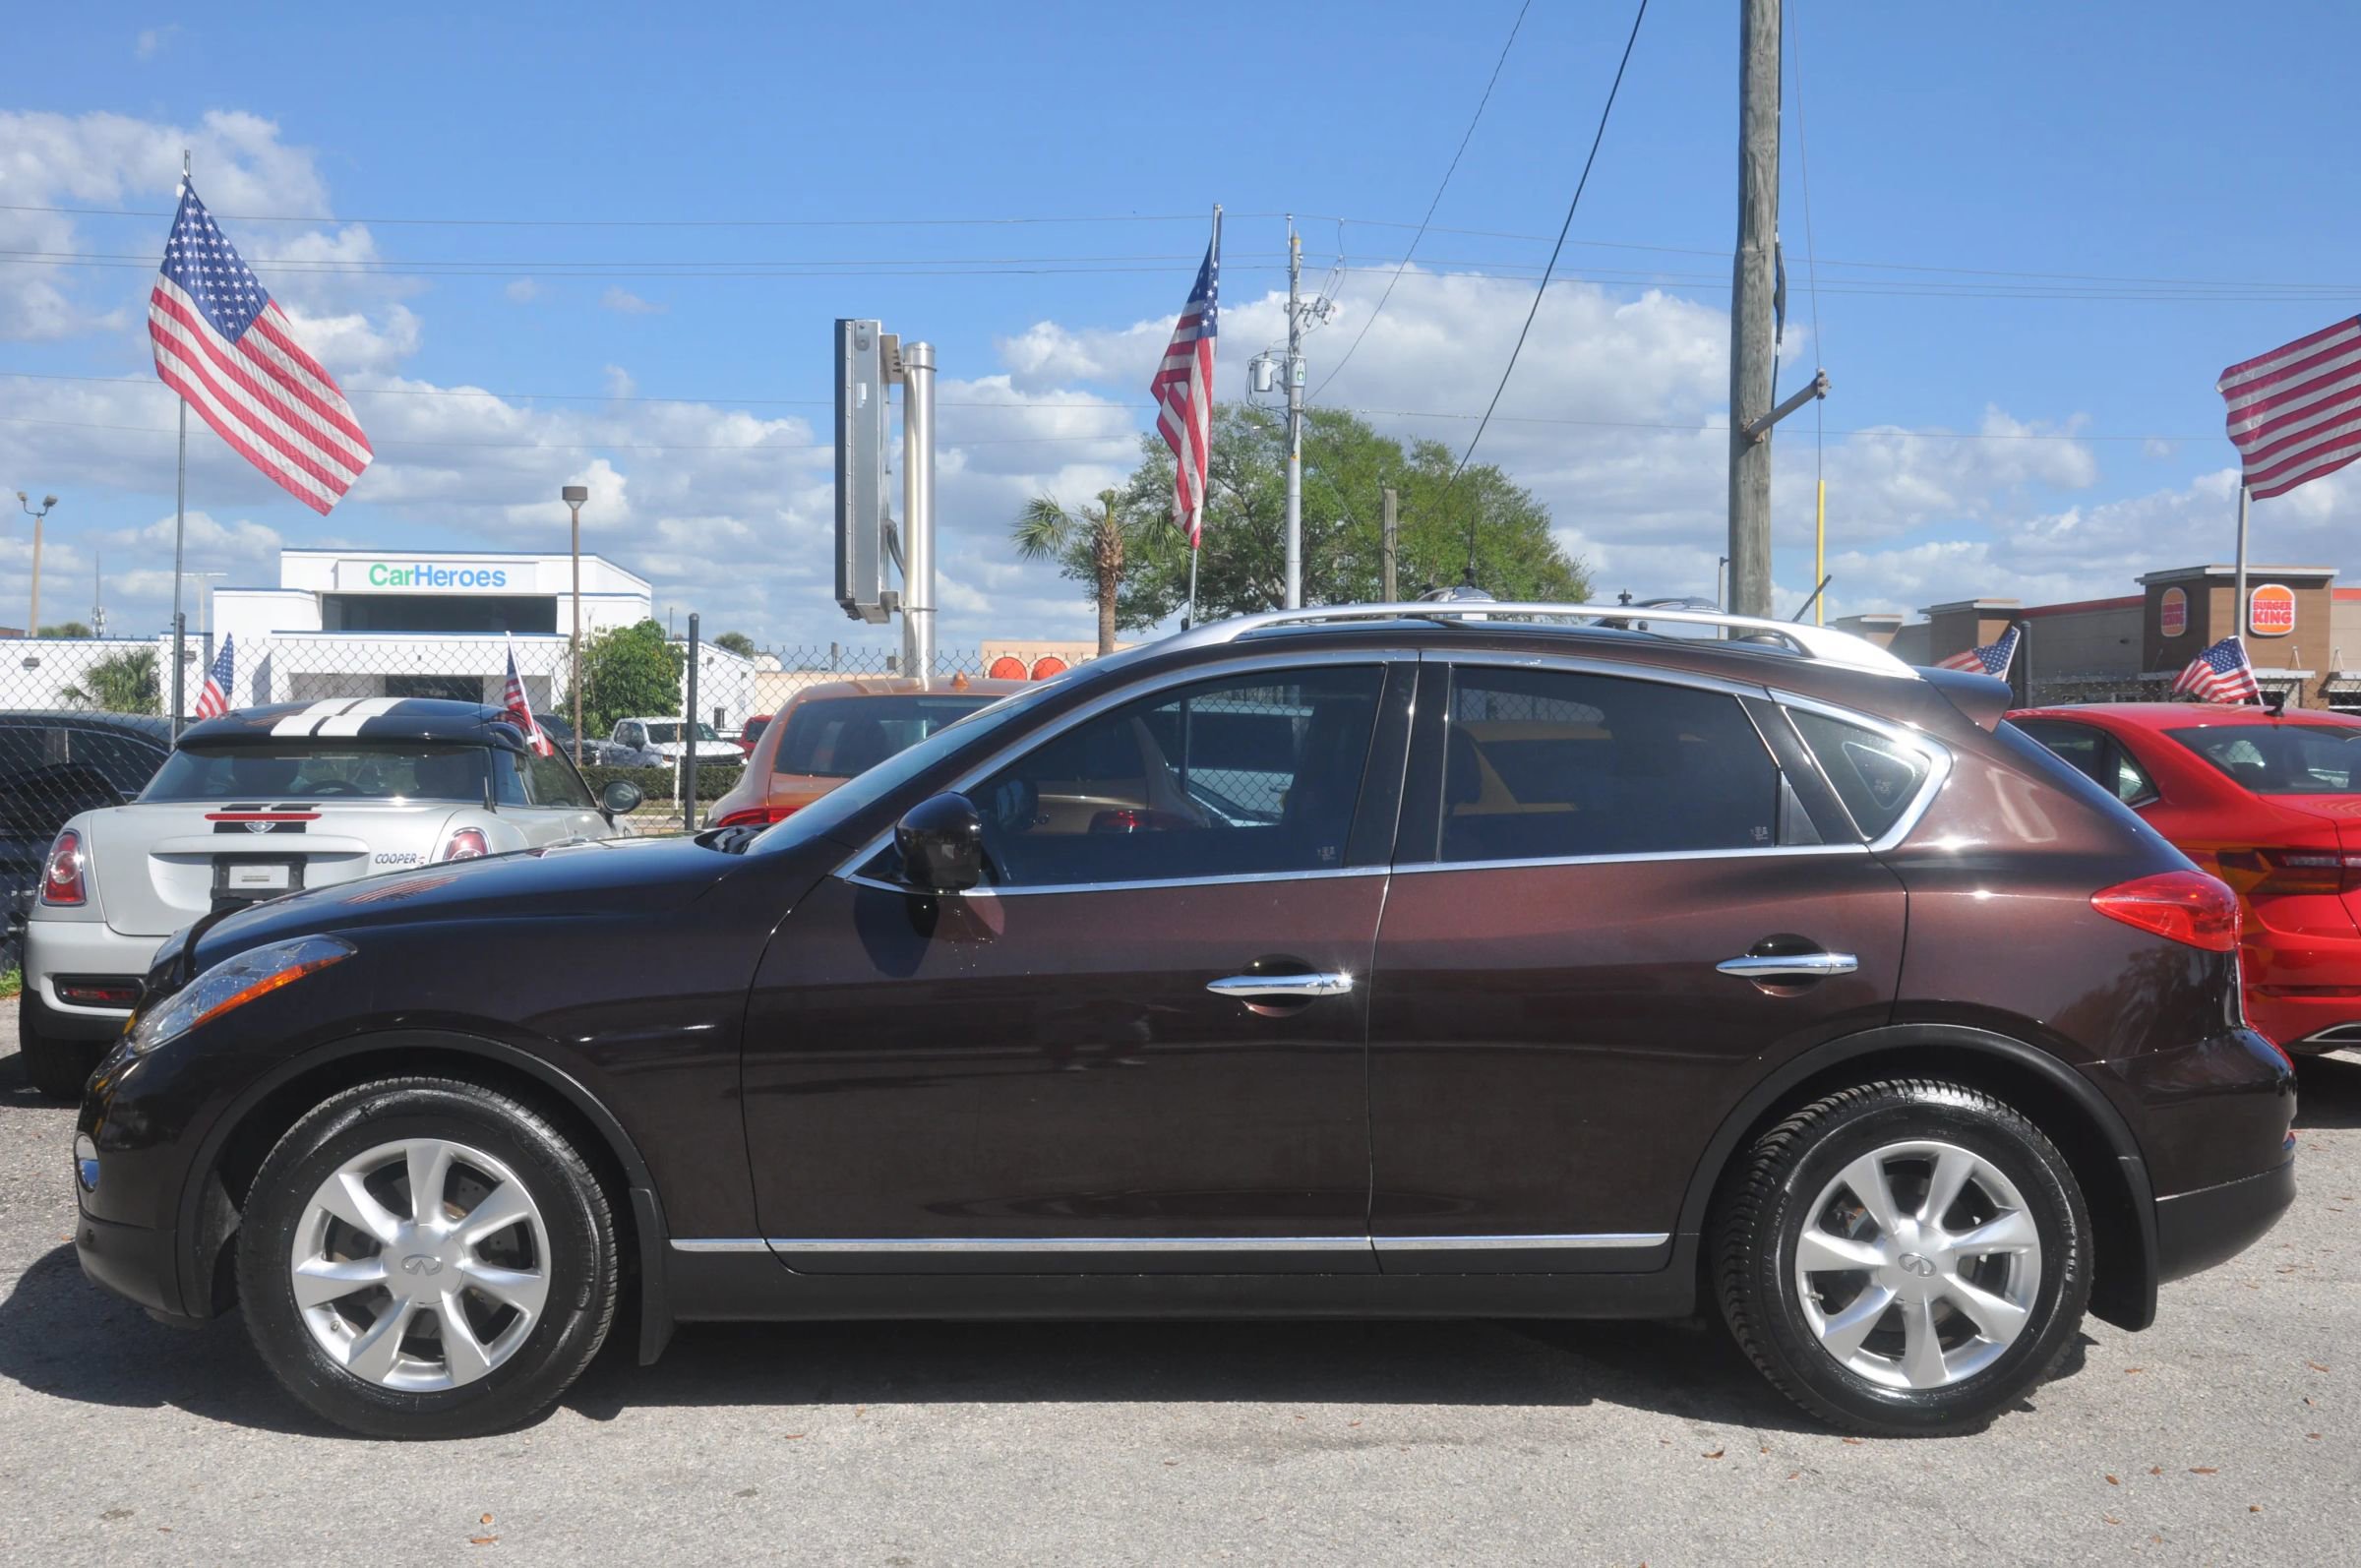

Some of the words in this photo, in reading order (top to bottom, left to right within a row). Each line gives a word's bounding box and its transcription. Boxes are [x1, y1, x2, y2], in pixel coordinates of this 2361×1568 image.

[368, 563, 507, 587] CarHeroes
[2253, 601, 2292, 611] BURGER
[2253, 610, 2292, 624] KING
[375, 853, 417, 865] COOPER
